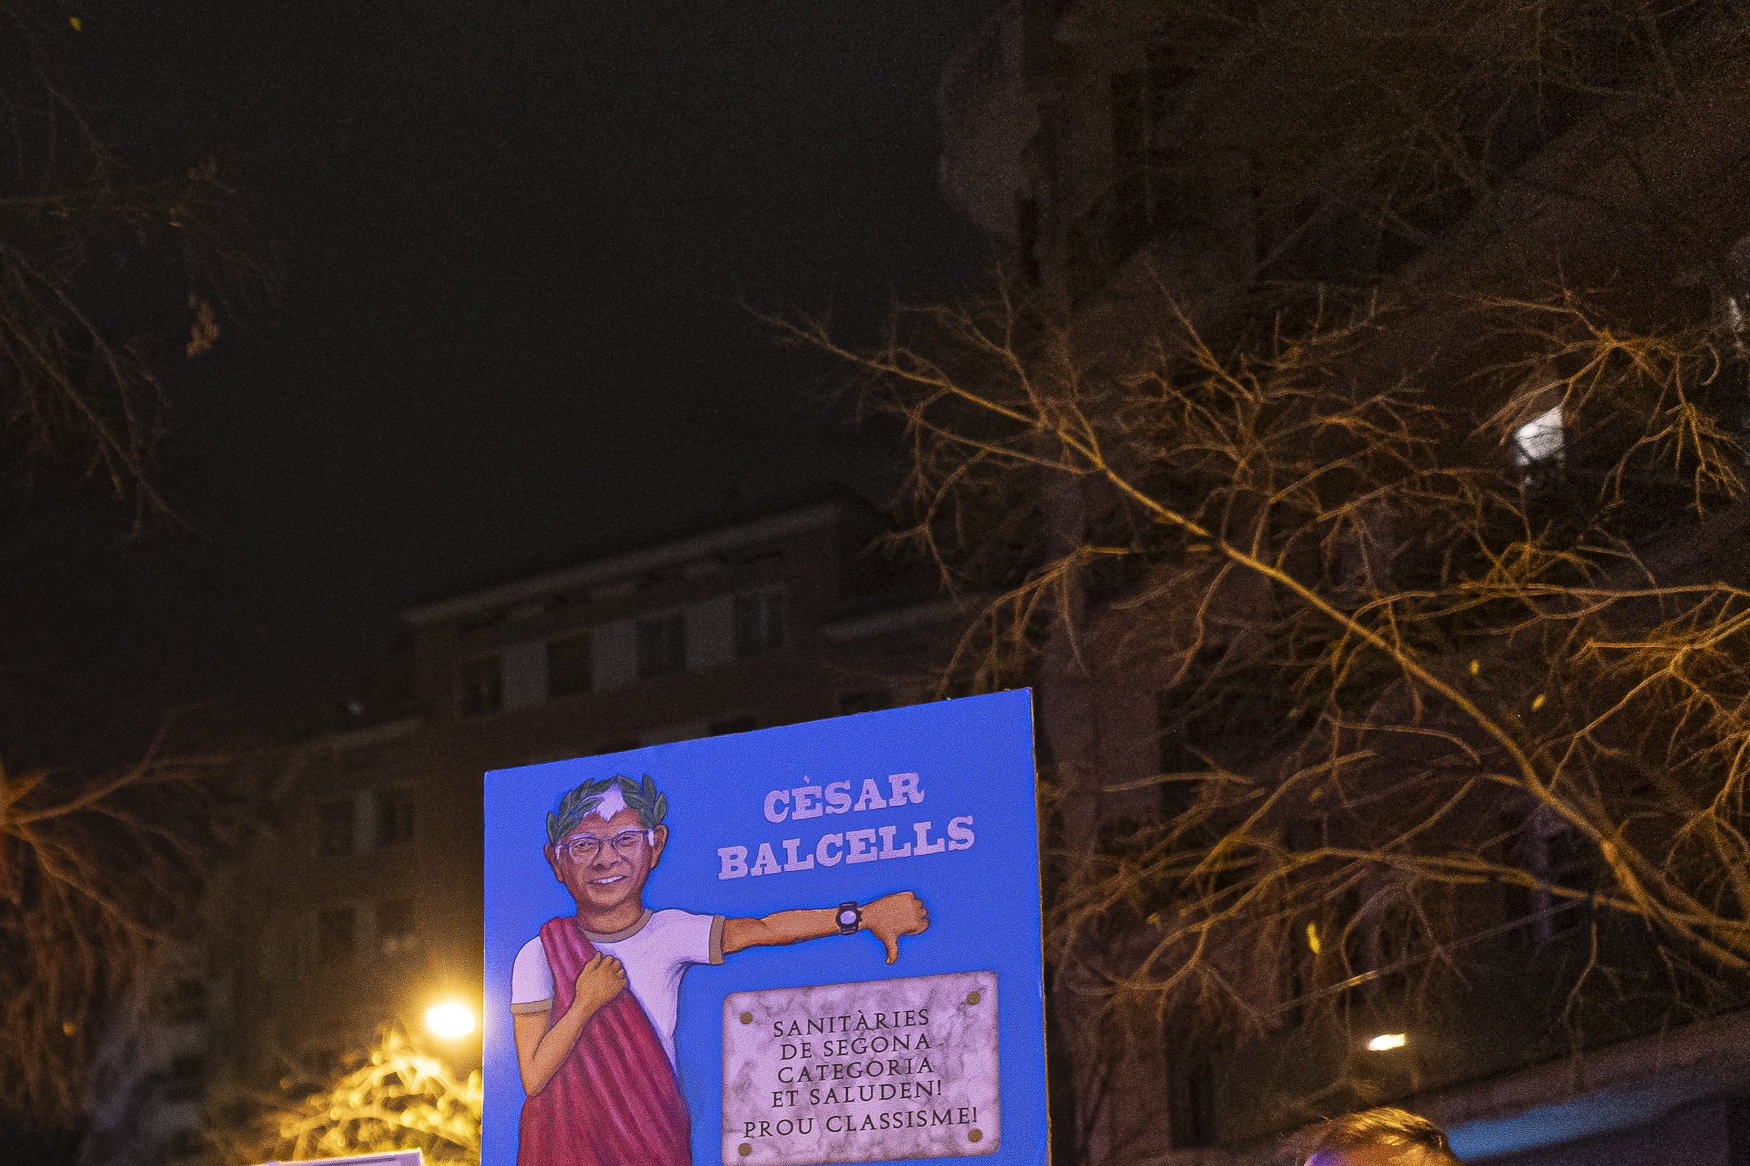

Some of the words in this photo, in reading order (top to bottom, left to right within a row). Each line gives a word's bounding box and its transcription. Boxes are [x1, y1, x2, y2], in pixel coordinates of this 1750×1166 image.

[763, 772, 925, 823] CÈSAR
[717, 816, 975, 880] BALCELLS
[773, 1008, 929, 1038] SANITÀRIES
[780, 1042, 812, 1060] DE
[823, 1033, 931, 1057] SEGONA
[777, 1057, 934, 1083] CATEGORIA
[771, 1089, 799, 1108] ET
[810, 1080, 942, 1105] SALUDEN!
[744, 1118, 814, 1138] PROU
[826, 1107, 977, 1133] CLASSISME!
